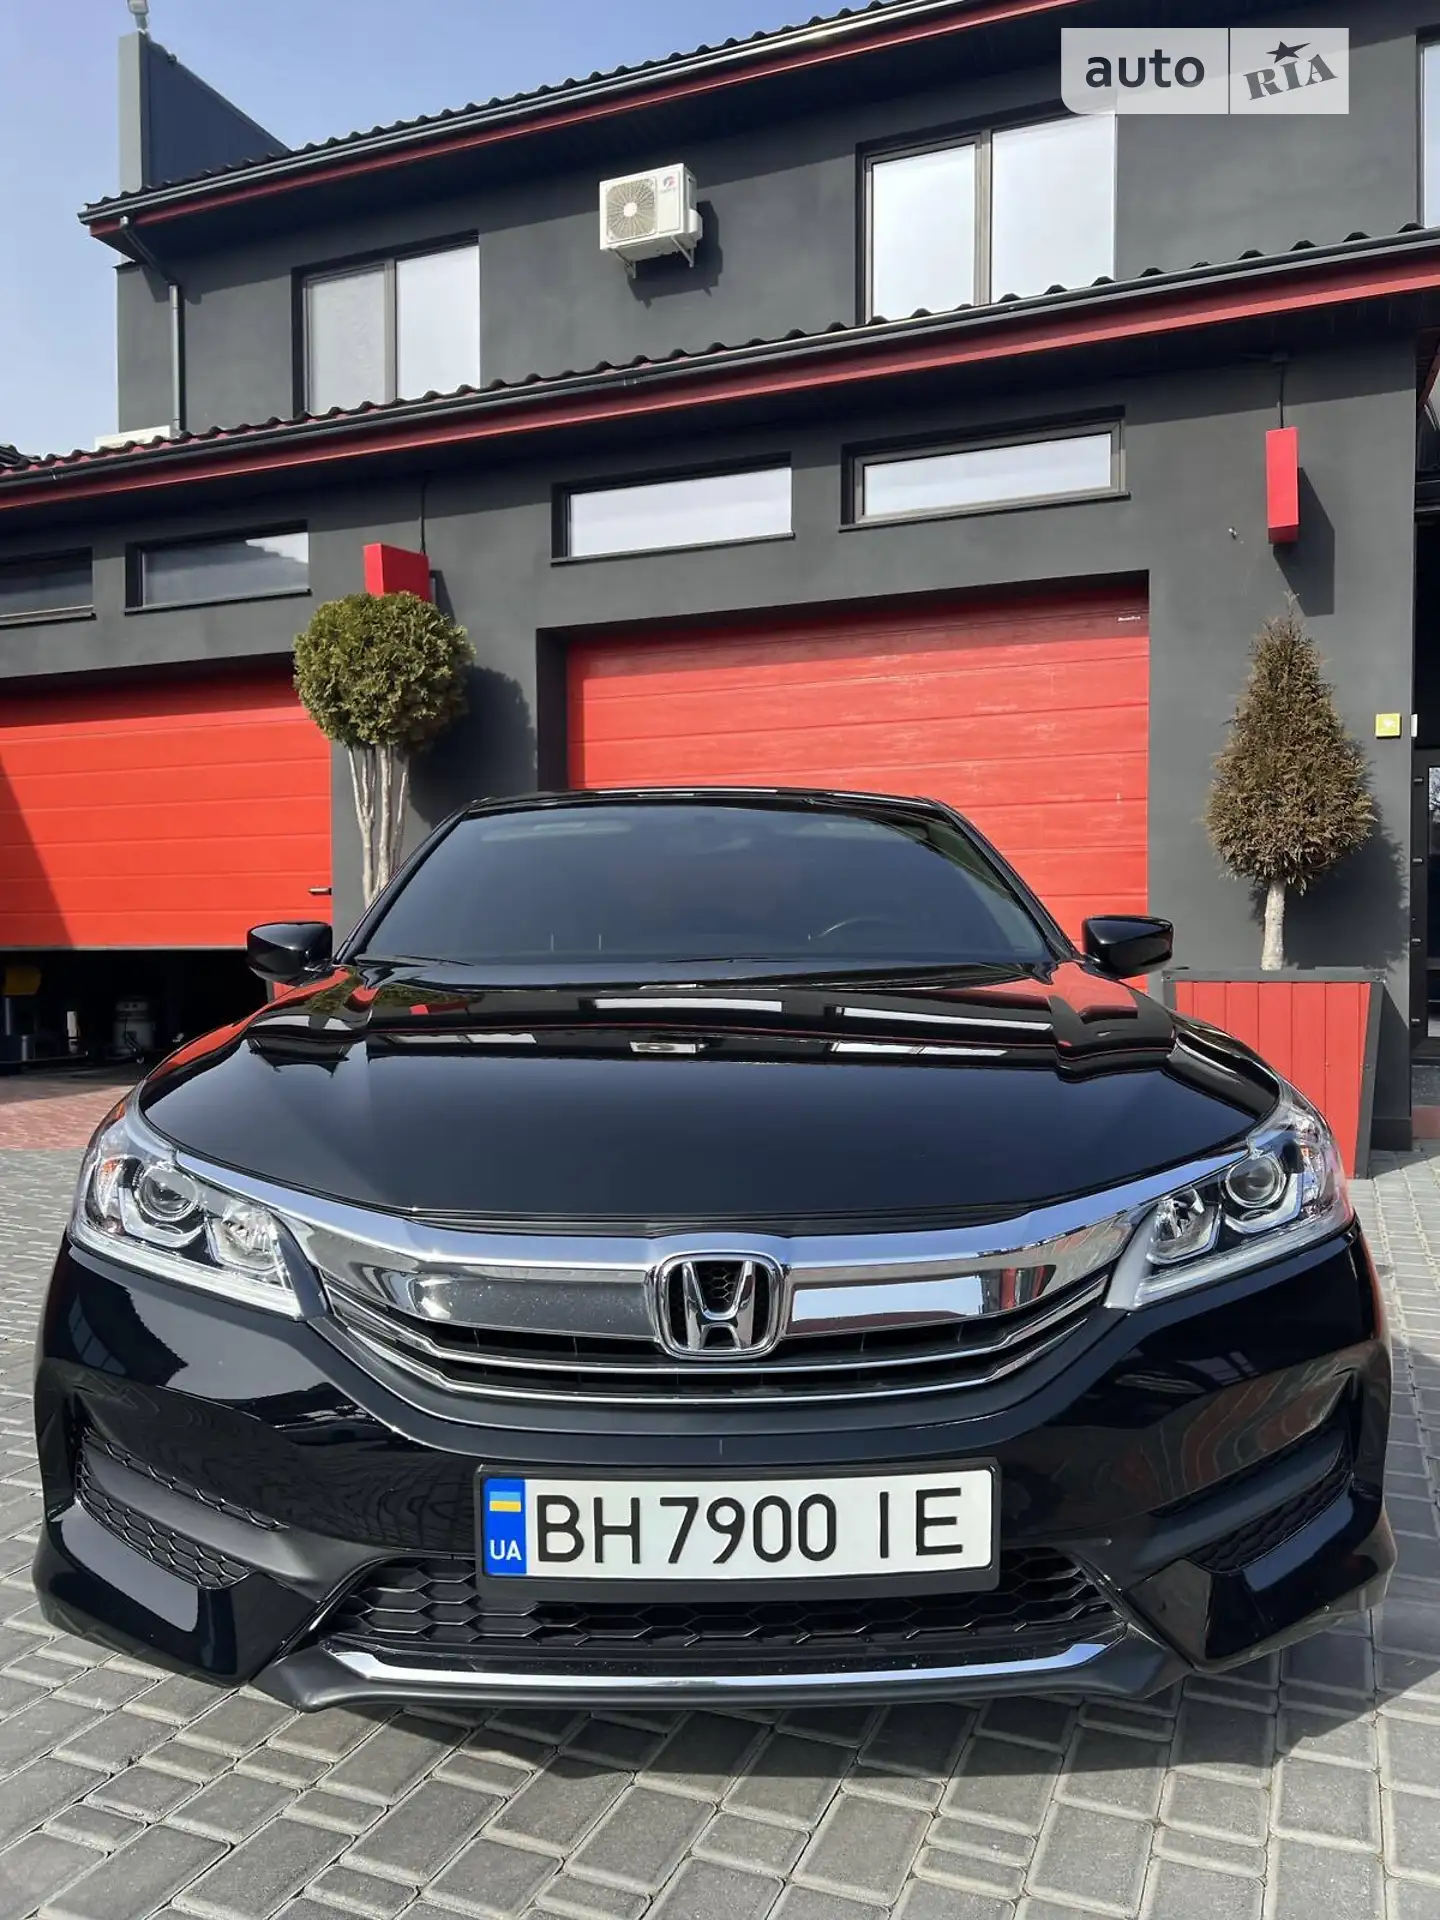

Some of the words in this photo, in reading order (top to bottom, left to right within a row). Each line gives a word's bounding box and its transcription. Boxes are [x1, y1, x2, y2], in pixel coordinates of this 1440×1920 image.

[489, 1539, 522, 1561] UA
[536, 1494, 641, 1564] BH
[659, 1493, 837, 1564] 7900
[879, 1487, 963, 1559] IE
